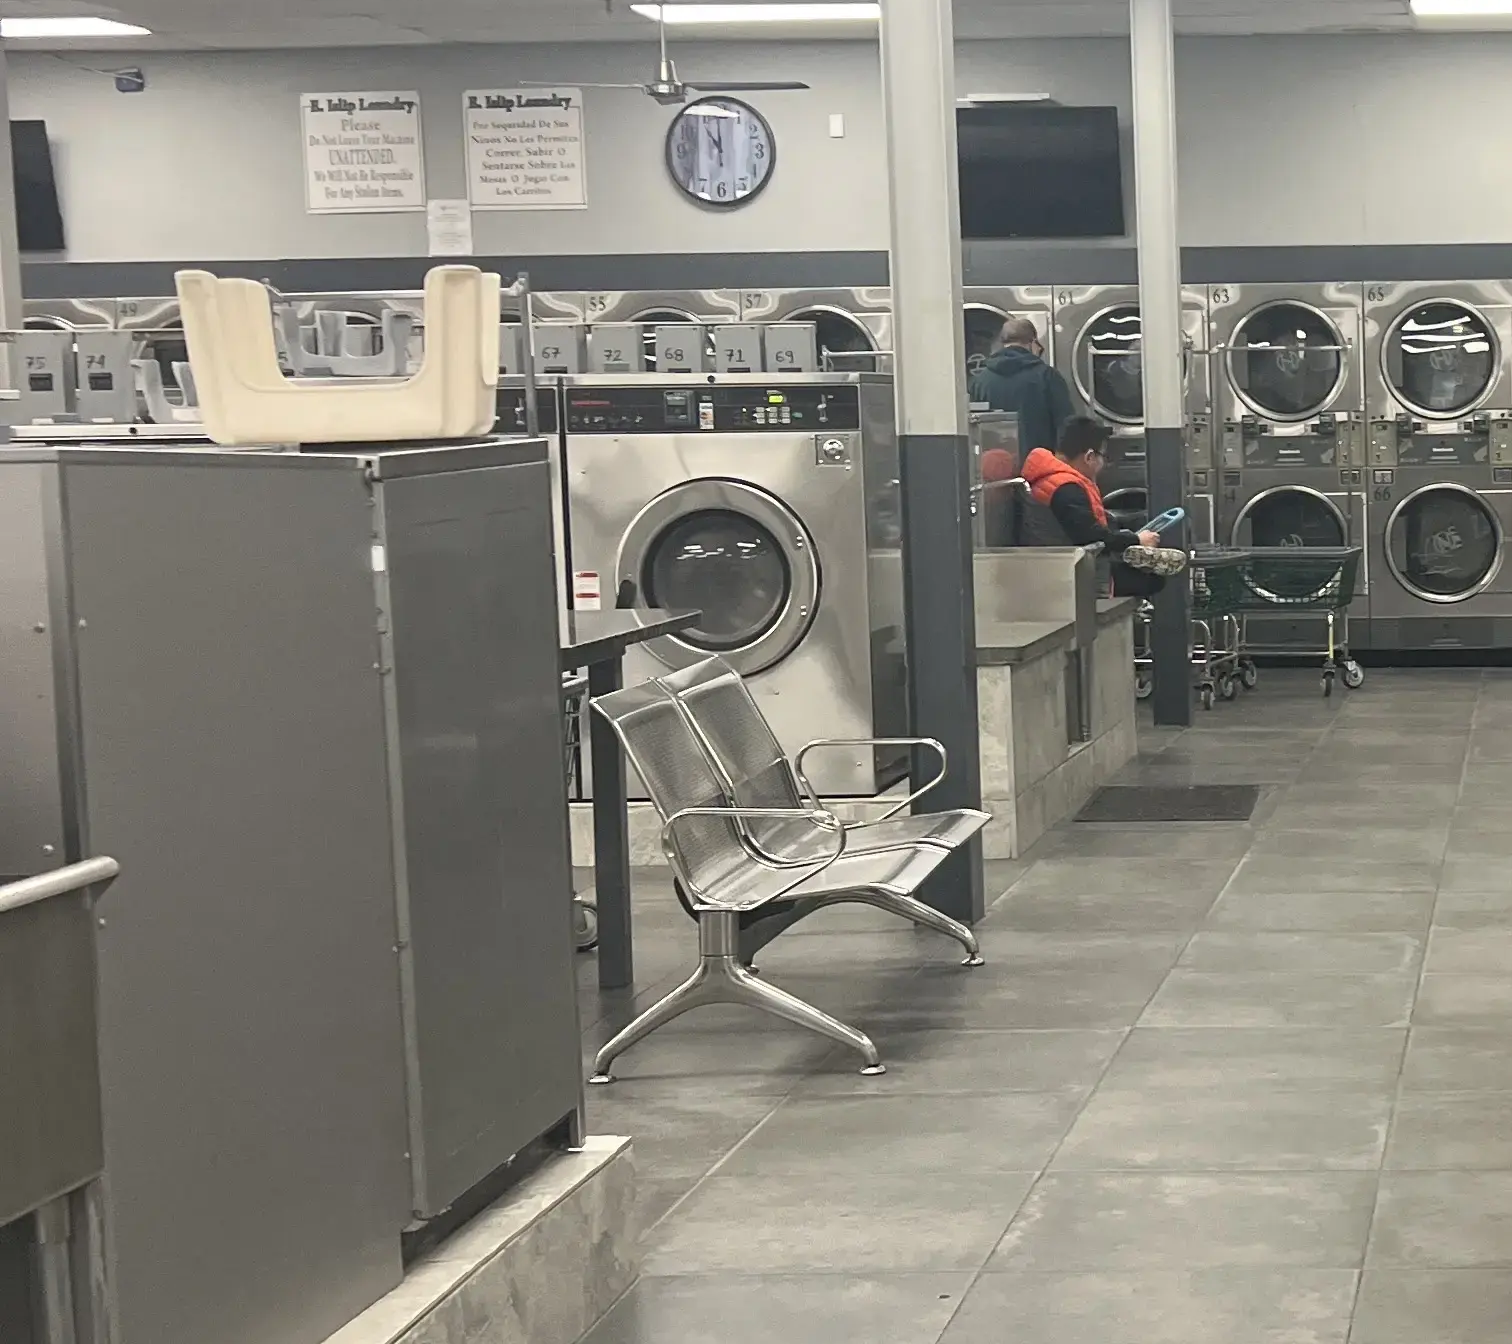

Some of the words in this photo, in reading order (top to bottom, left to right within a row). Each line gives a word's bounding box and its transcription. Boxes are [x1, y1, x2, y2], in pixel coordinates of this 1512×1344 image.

[341, 118, 380, 131] Please
[539, 120, 551, 129] De
[557, 147, 566, 156] O
[755, 143, 765, 160] 3
[716, 181, 727, 198] 6
[1058, 291, 1074, 306] 61
[1213, 288, 1229, 303] 63
[1367, 286, 1385, 301] 65
[589, 296, 607, 312] 55
[745, 294, 762, 309] 57
[541, 347, 561, 360] 67
[603, 348, 623, 362] 72
[664, 348, 684, 361] 68
[725, 348, 745, 362] 71
[775, 350, 795, 363] 69
[25, 357, 46, 369] 75
[1373, 486, 1391, 501] 66
